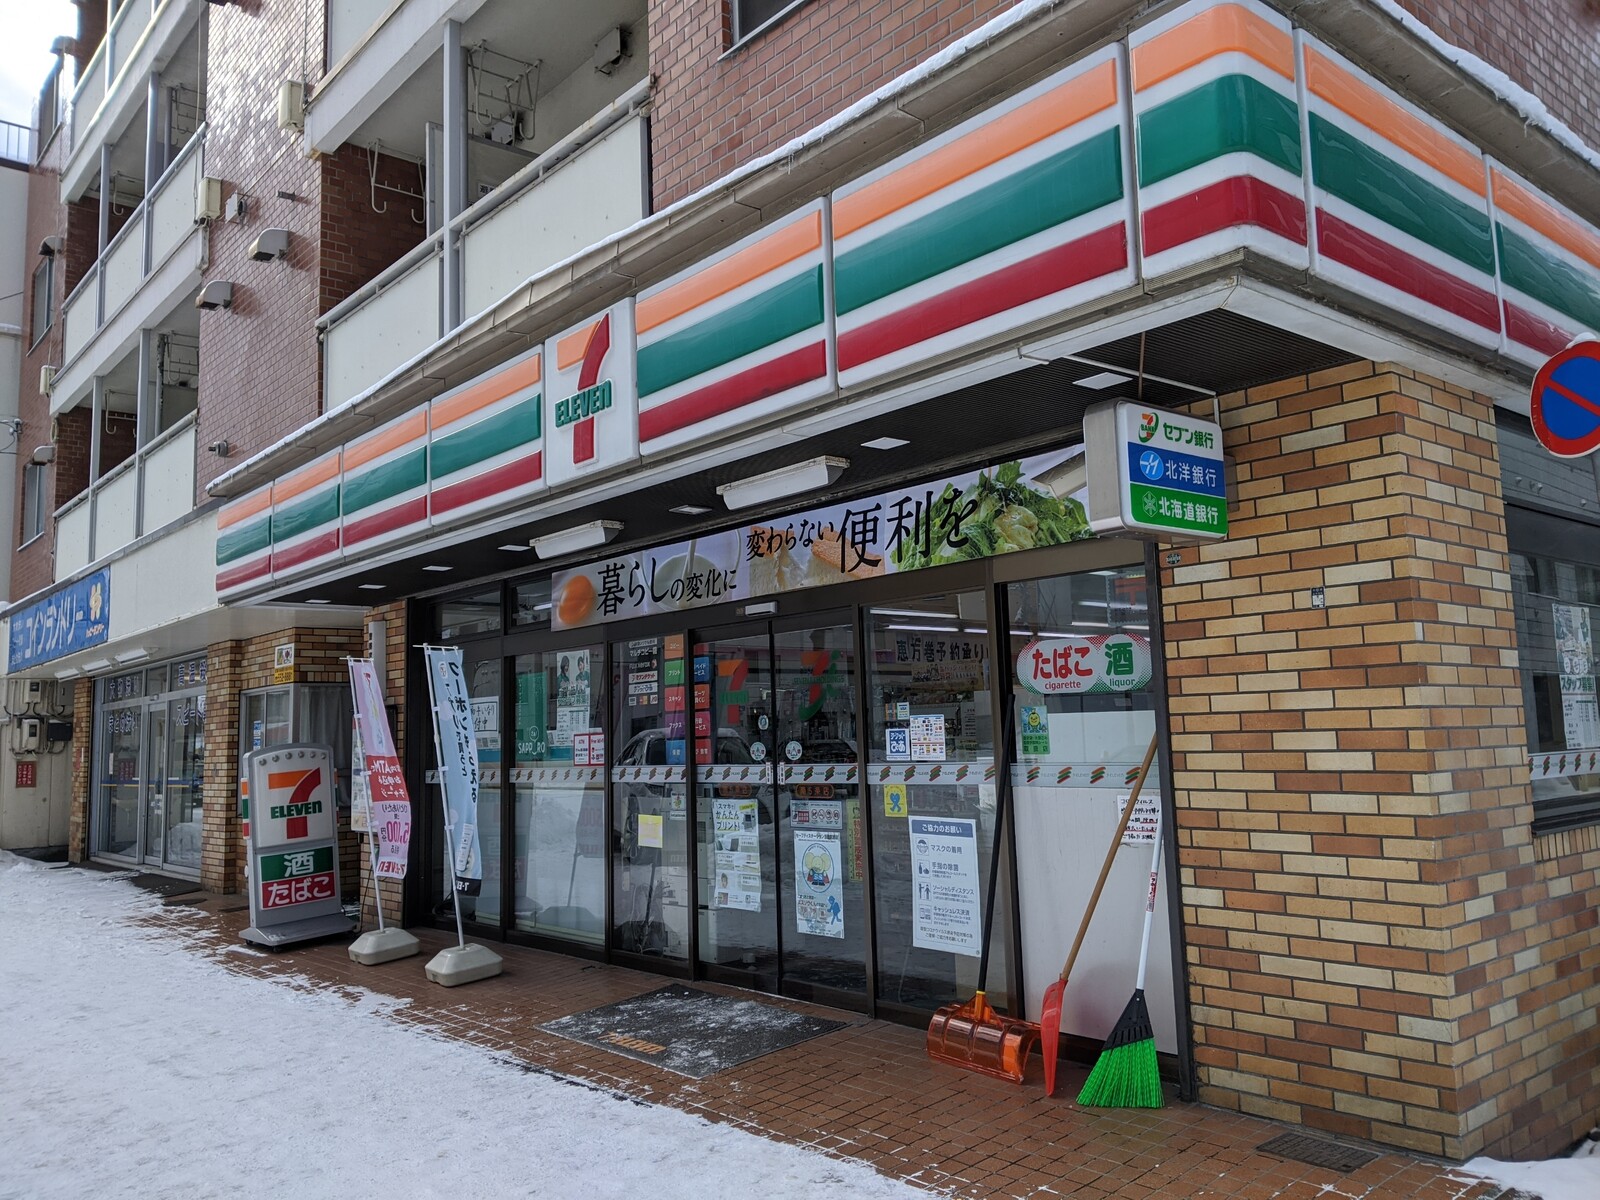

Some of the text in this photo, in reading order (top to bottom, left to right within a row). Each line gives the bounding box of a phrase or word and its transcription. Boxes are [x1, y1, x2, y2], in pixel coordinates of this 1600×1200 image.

[1163, 422, 1213, 449] セブン銀行
[1165, 459, 1216, 487] 北洋銀行
[1159, 496, 1218, 525] 北海道銀行
[597, 488, 978, 617] 暮らしの変化に 変わらない便利を
[25, 593, 83, 659] コインランドリー
[1032, 642, 1134, 680] たばこ 酒
[1044, 678, 1136, 692] cigarette liquor
[890, 740, 906, 752] ぴあ
[715, 810, 740, 820] かんたん
[921, 823, 962, 834] ご協力のお願い
[930, 844, 963, 855] マスクの着用
[283, 850, 315, 877] 酒
[267, 877, 331, 906] たばこ
[932, 884, 975, 895] ソーシャルディスタンス
[933, 905, 970, 916] キャッシュレス決済
